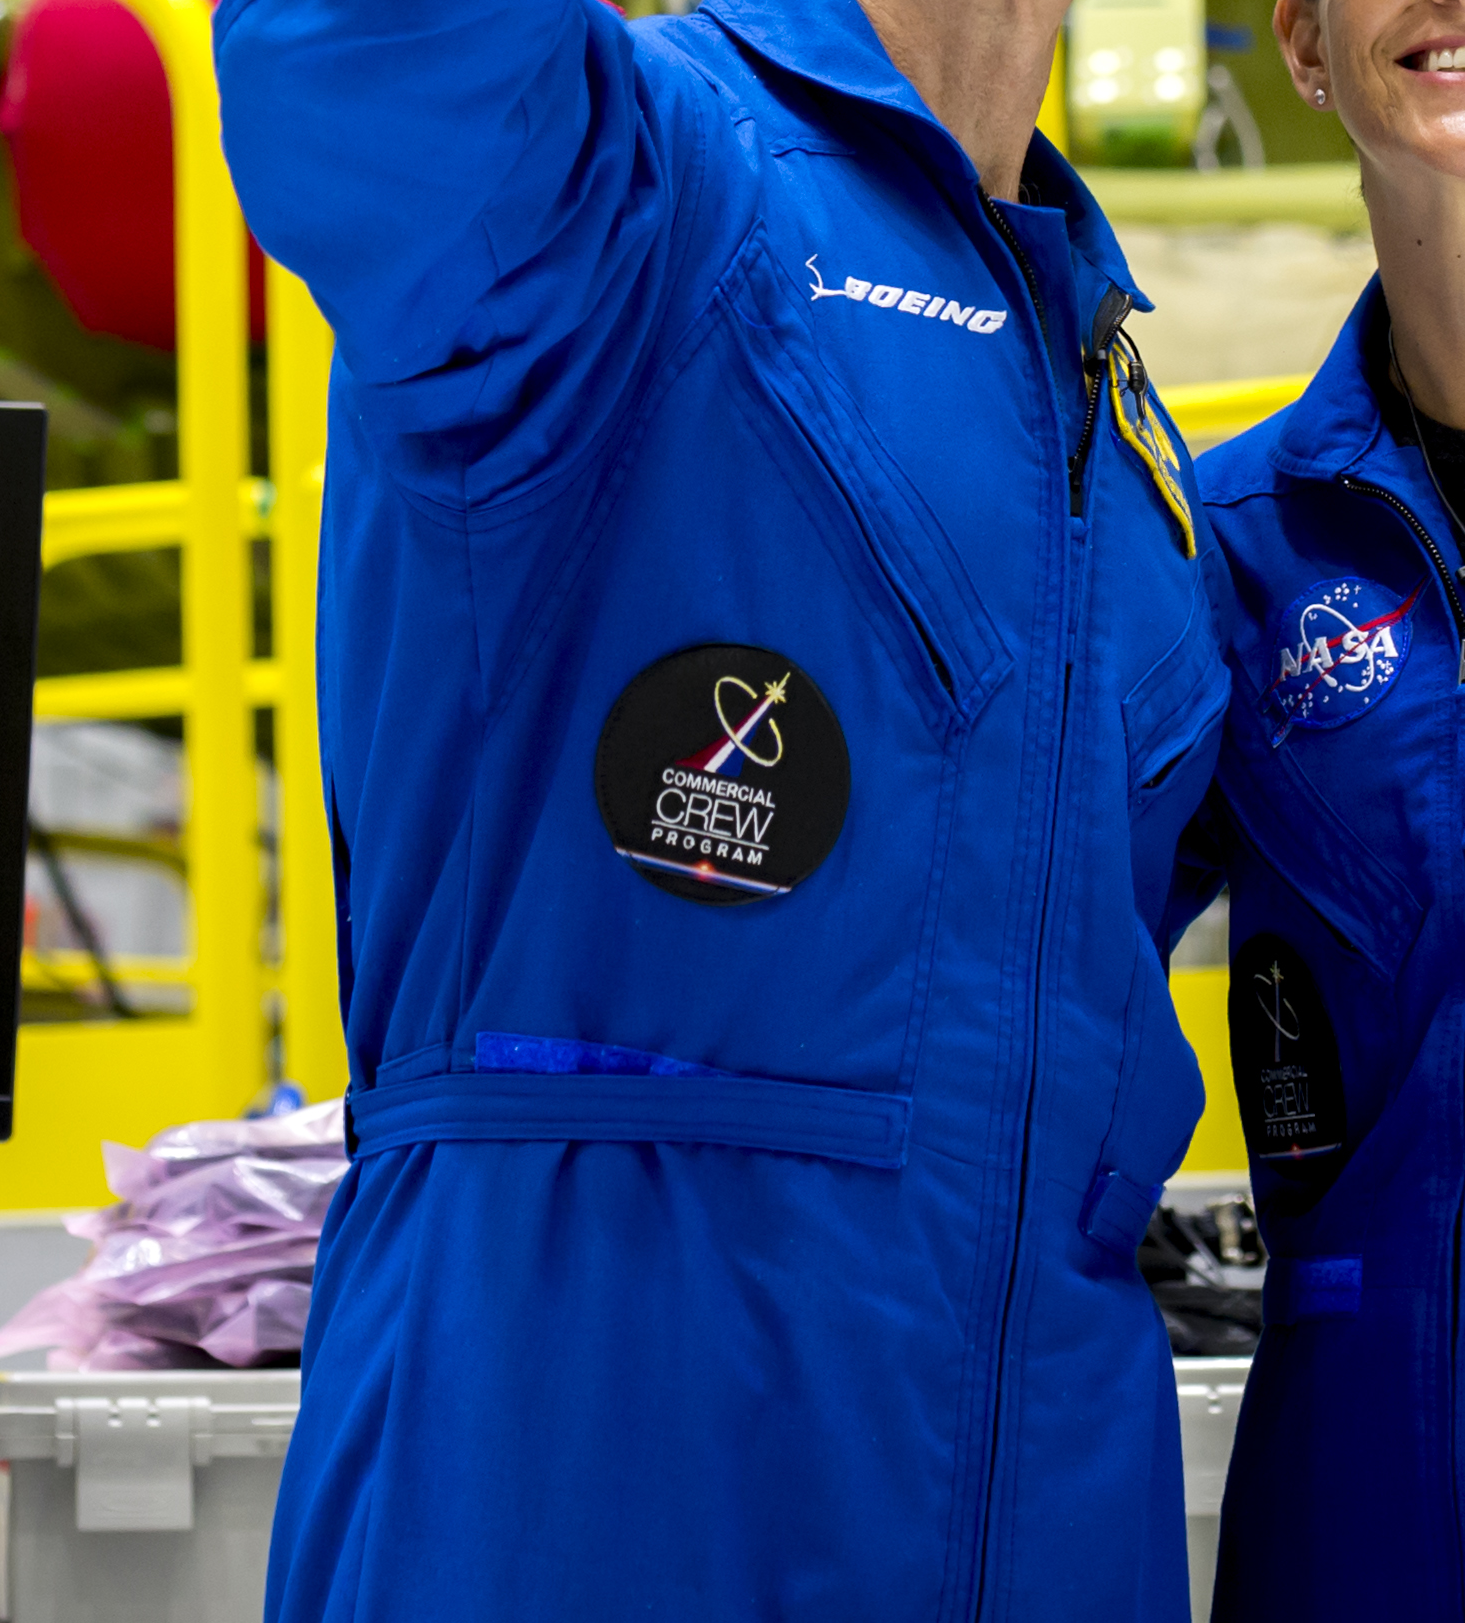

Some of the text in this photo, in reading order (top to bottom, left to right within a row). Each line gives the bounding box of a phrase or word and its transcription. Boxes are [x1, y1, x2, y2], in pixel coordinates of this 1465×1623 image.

[844, 276, 1008, 335] BOEING
[1280, 625, 1399, 681] NASA
[662, 768, 776, 809] COMMERCIAL
[656, 788, 774, 844] CREW
[651, 827, 763, 866] PROGRAM
[1260, 1065, 1308, 1083] COMMERCIAL
[1263, 1082, 1309, 1117] CREW
[1267, 1121, 1317, 1137] PROGRAM
